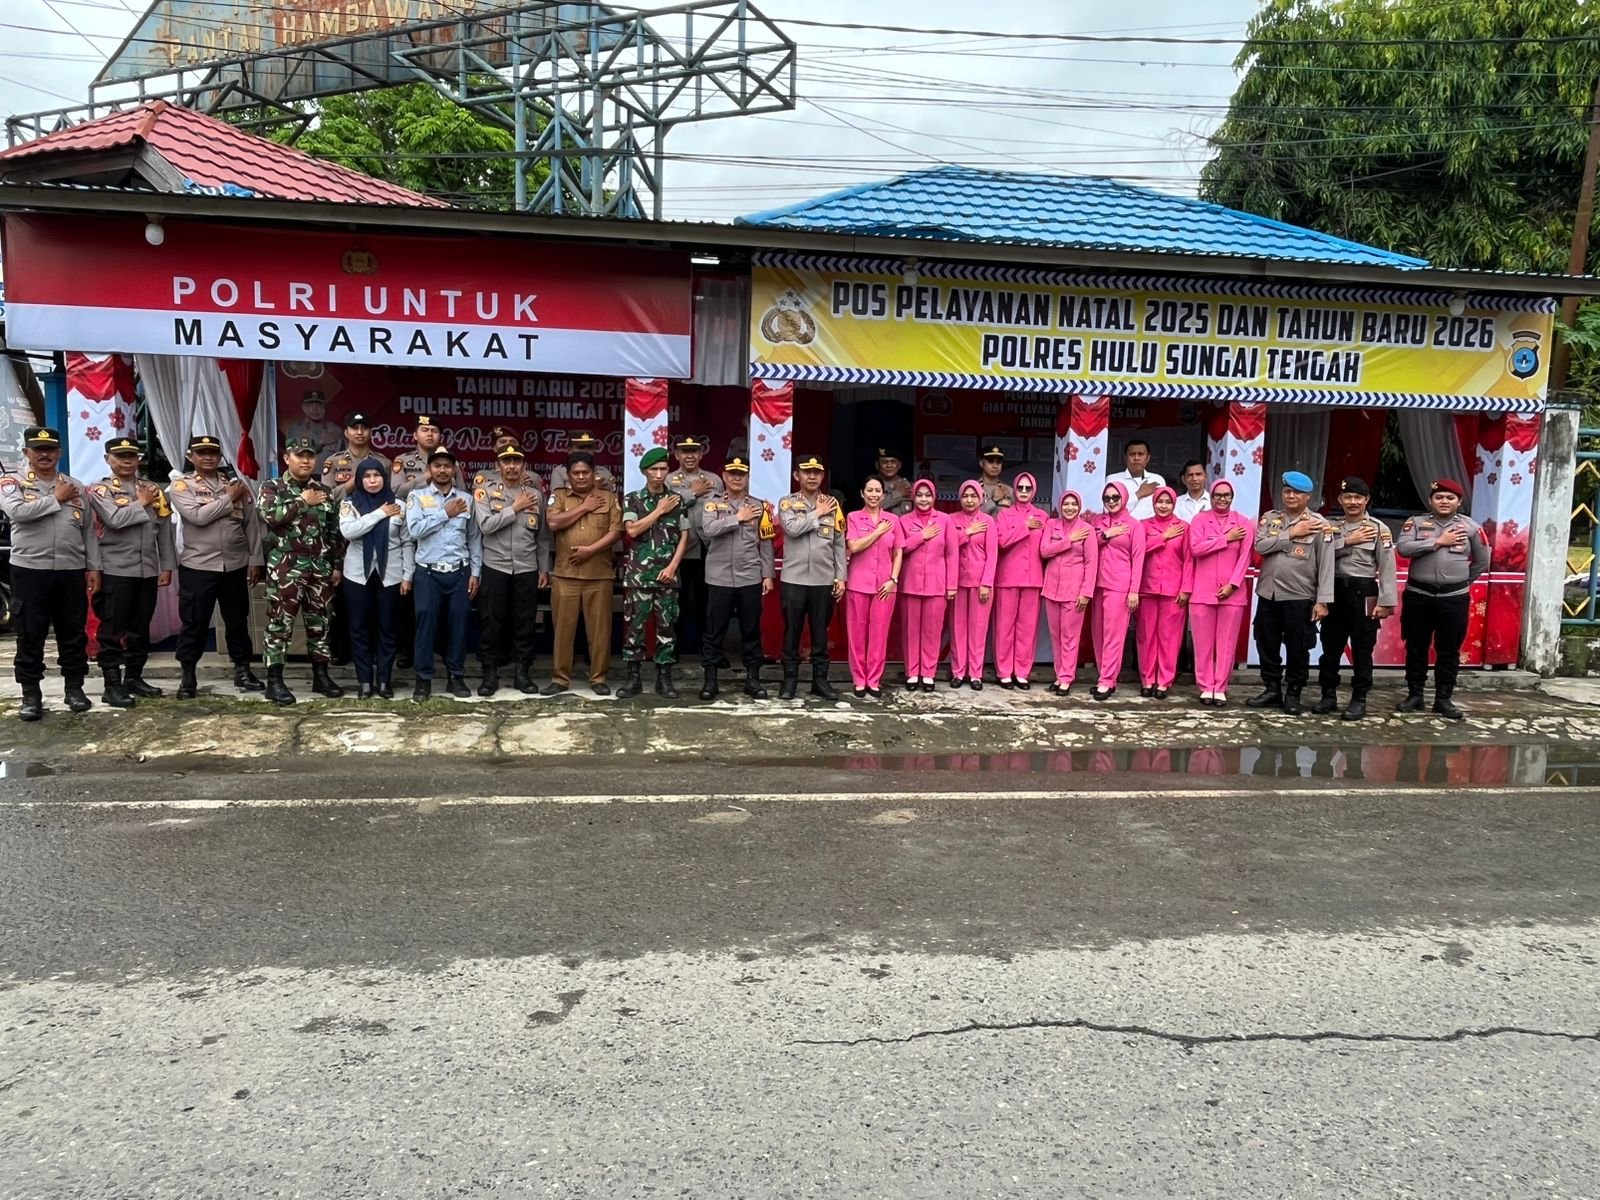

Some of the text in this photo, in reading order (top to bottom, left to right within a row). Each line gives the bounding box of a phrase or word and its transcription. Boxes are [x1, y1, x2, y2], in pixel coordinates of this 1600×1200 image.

[168, 21, 261, 65] PANTAI
[172, 276, 539, 322] POLRI UNTUK
[832, 281, 1494, 349] POS PELAYANAN NATAL 2025 DAN TAHUN BARU 2026
[174, 318, 539, 360] MASYARAKAT
[983, 334, 1361, 383] POLRES HULU SUNGAI TENGAH
[399, 396, 474, 416] POLRES
[480, 399, 530, 418] HULU
[535, 401, 605, 421] SUNGAI
[456, 376, 517, 395] TAHUN
[522, 379, 576, 399] BARU
[1007, 402, 1057, 415] PELAYANA
